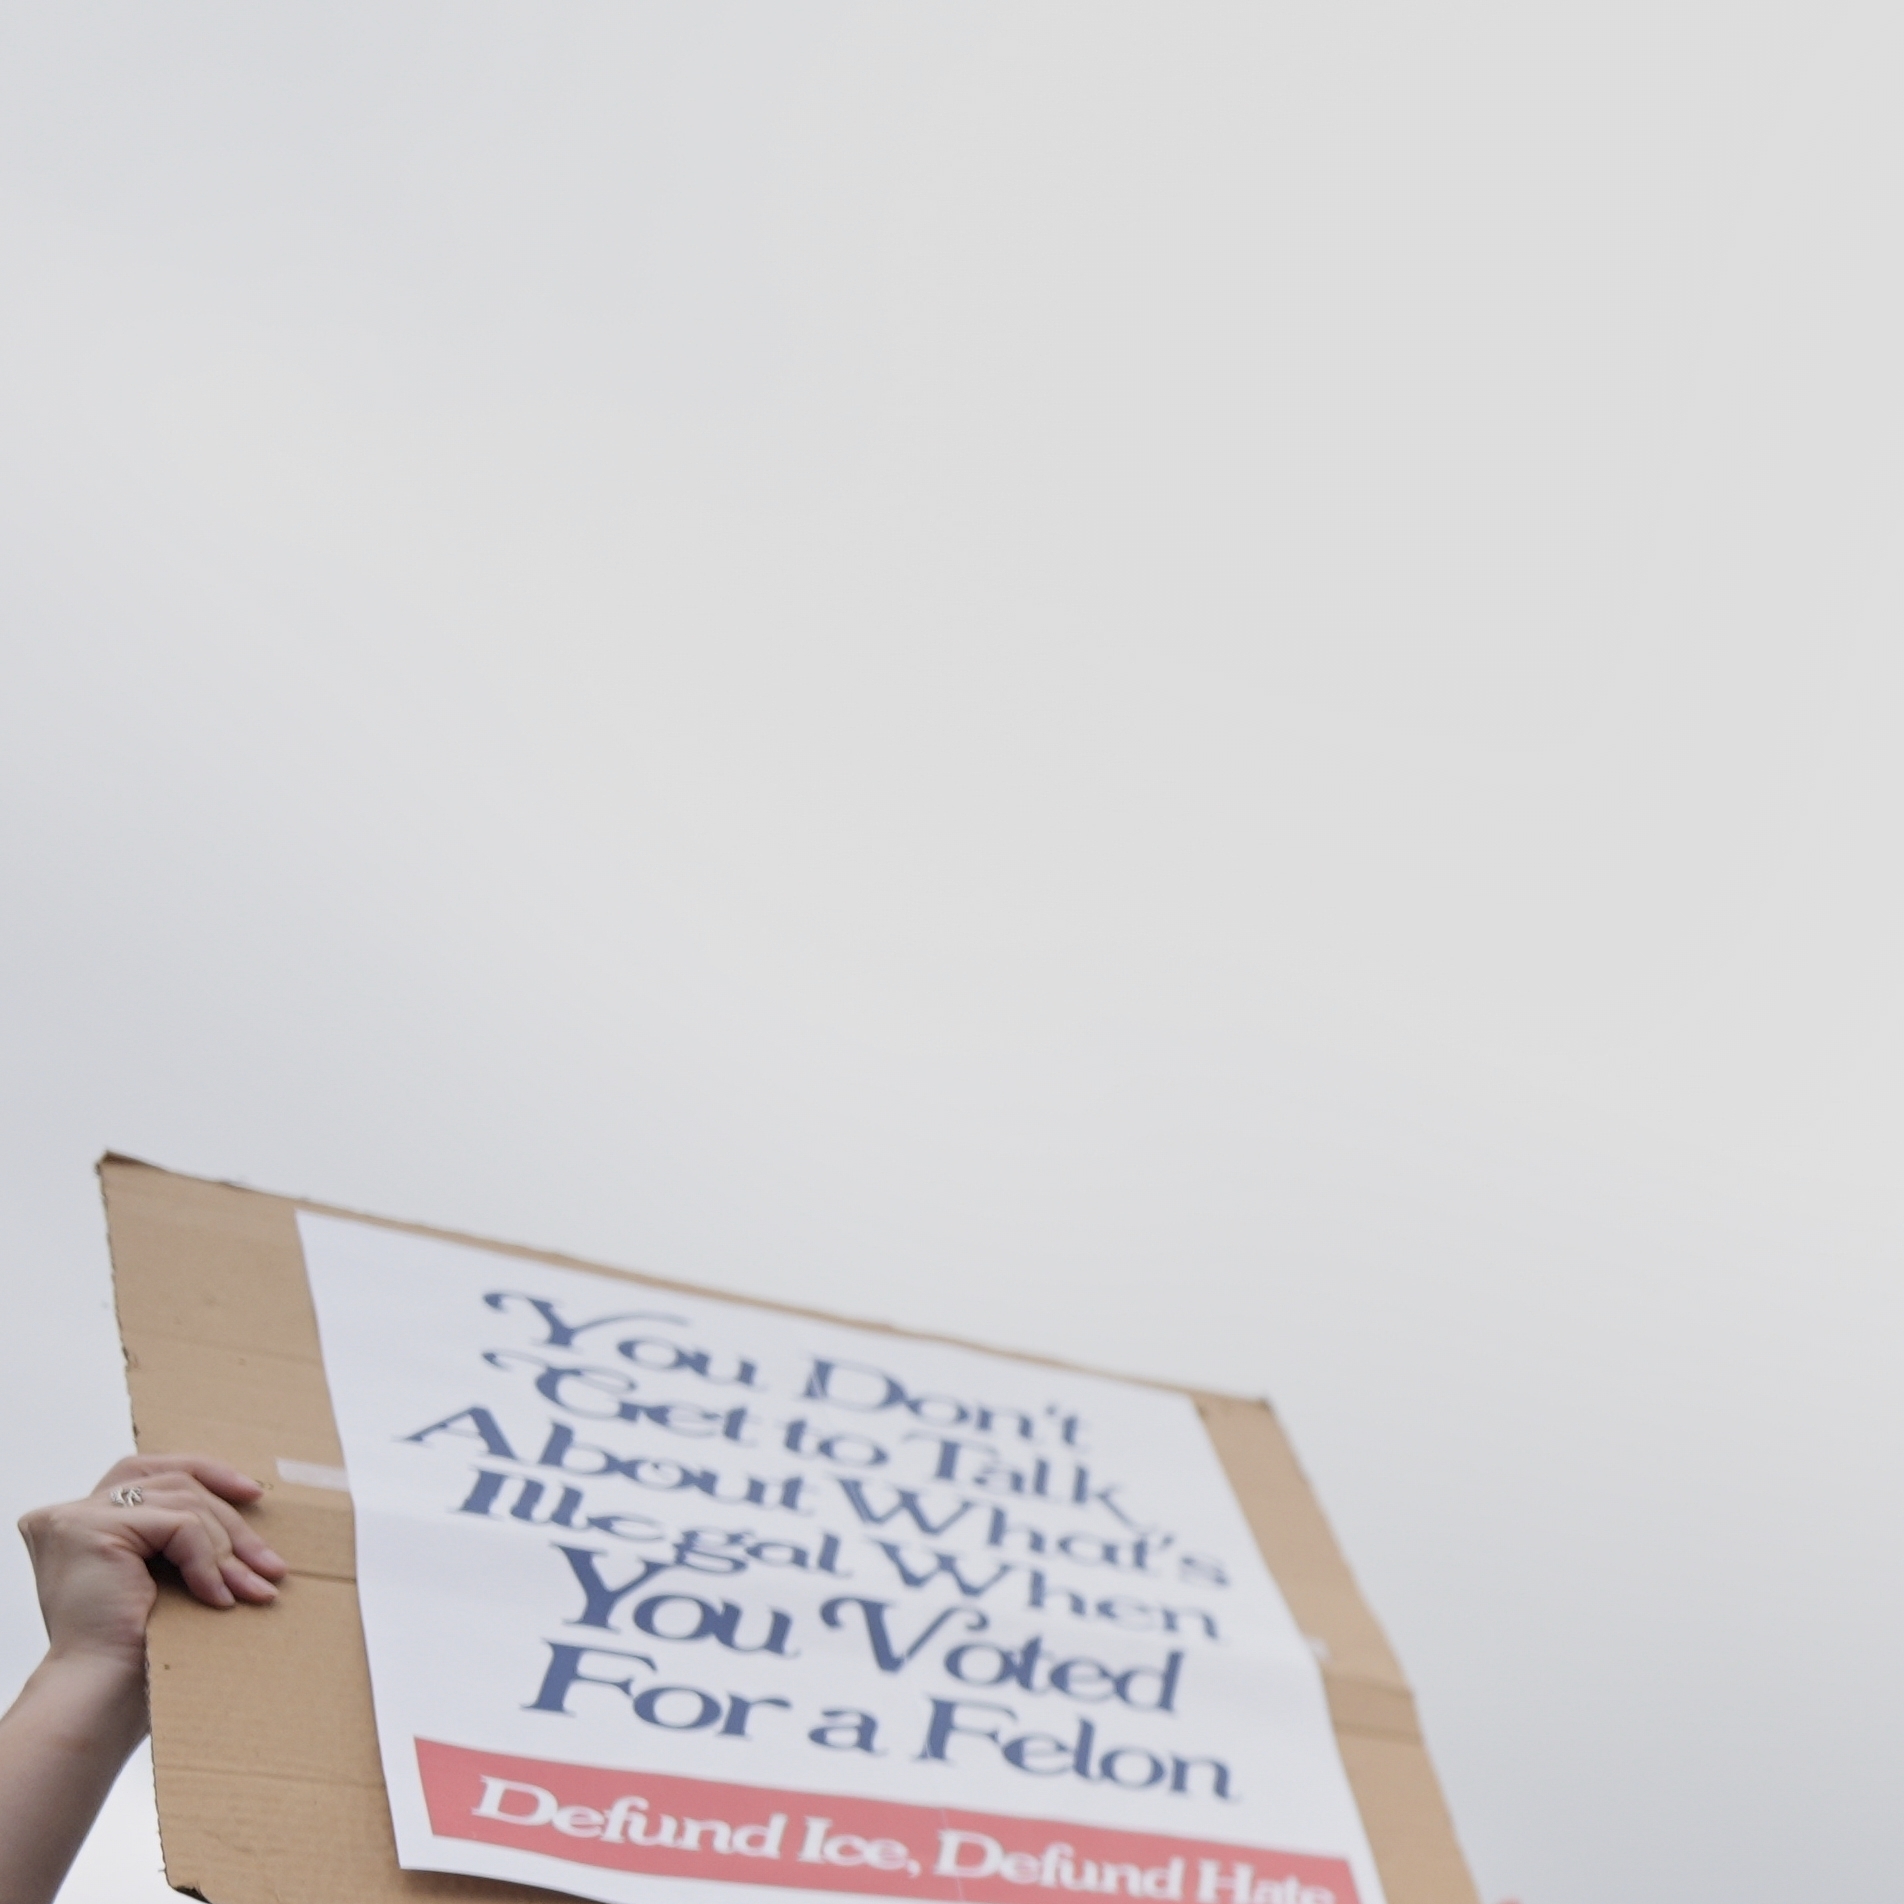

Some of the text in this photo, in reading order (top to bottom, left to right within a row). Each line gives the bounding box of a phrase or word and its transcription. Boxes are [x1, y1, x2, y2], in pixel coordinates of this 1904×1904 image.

[482, 1290, 1093, 1455] You Don't
[482, 1348, 1159, 1533] Get to Talk
[402, 1404, 1233, 1590] About What's
[454, 1464, 1223, 1643] Illegal When
[550, 1541, 1184, 1715] You Voted
[521, 1638, 1241, 1803] For a Felon
[470, 1773, 788, 1861] Defund
[791, 1816, 922, 1879] Ice,
[935, 1828, 1185, 1902] Defund
